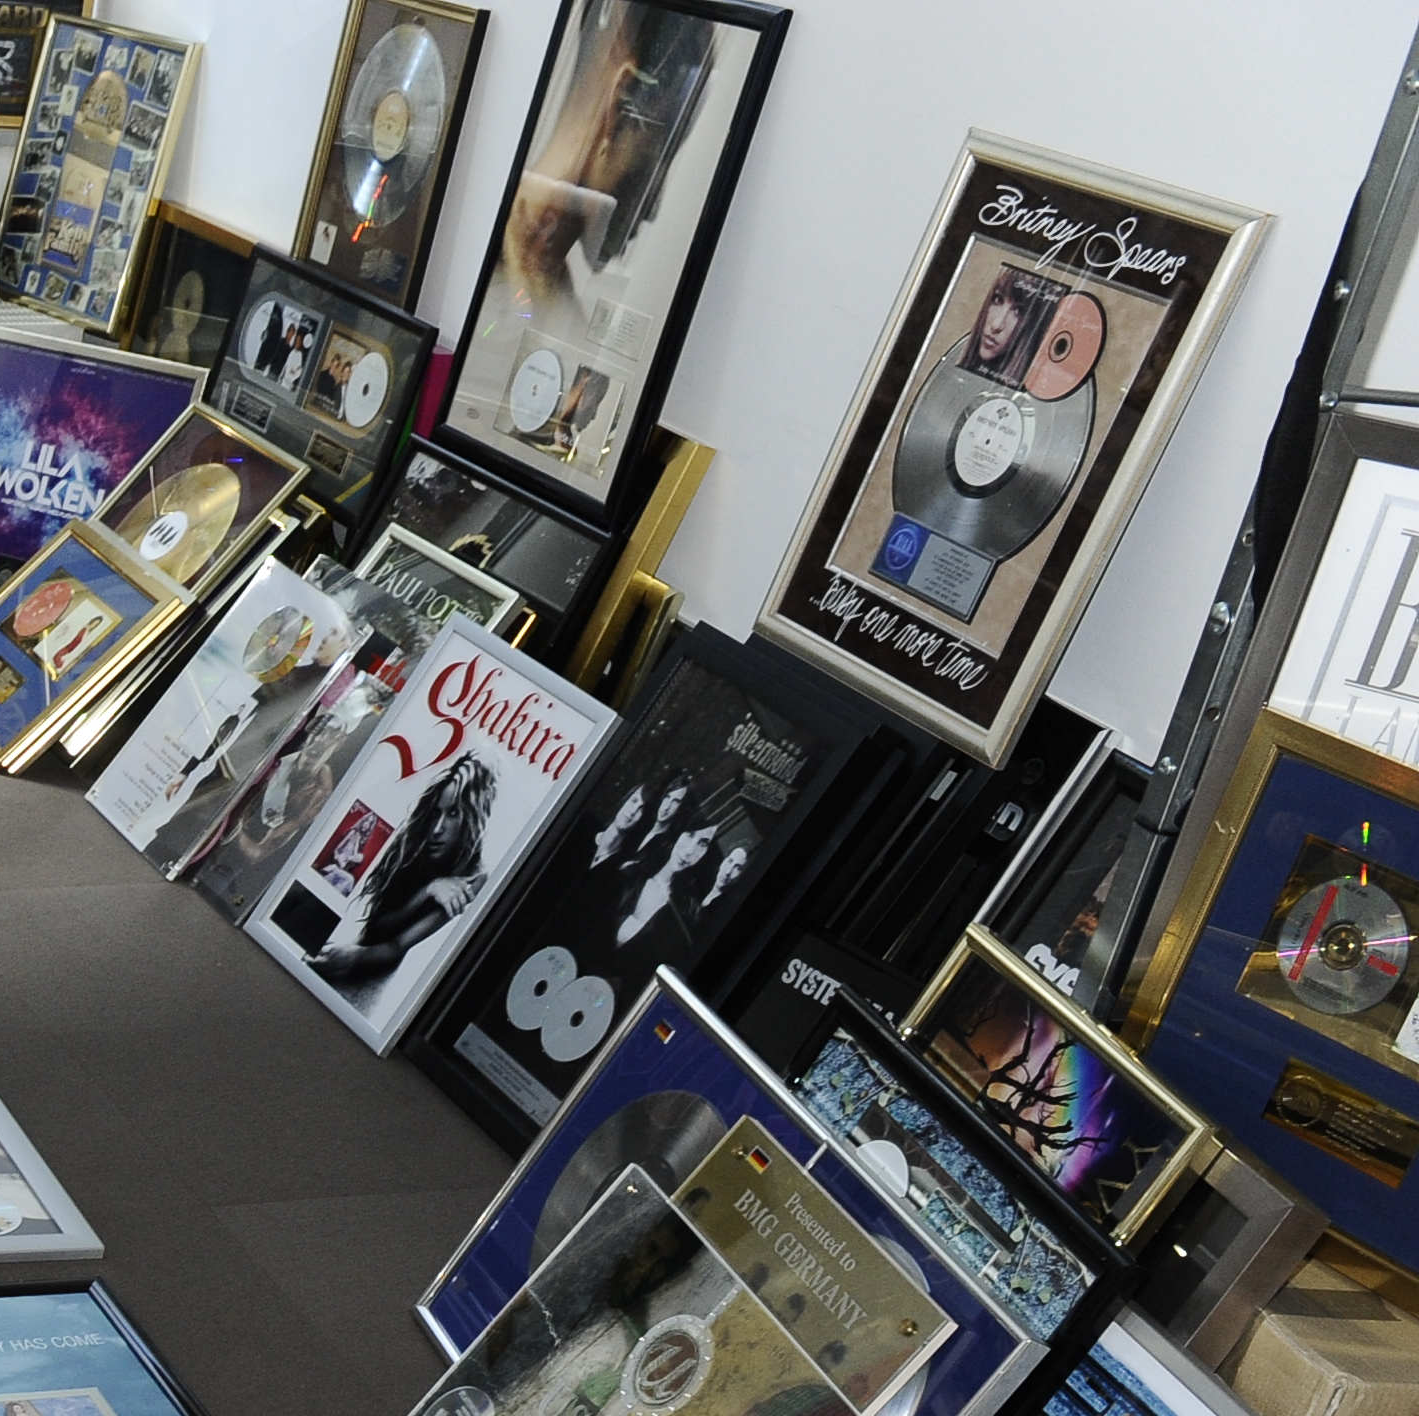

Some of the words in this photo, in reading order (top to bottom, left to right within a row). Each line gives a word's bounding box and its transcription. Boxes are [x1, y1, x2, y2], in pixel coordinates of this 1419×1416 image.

[979, 184, 1089, 270] Britney
[1084, 217, 1187, 284] Spears
[20, 437, 85, 481] LILA
[374, 559, 423, 607] PAUL
[378, 653, 576, 783] Shakira
[781, 957, 841, 1007] SYSTE
[733, 1188, 773, 1240] BMG
[772, 1230, 868, 1331] GERMANY
[783, 1191, 843, 1258] Presented
[840, 1250, 858, 1273] to
[11, 1338, 48, 1352] HAS
[52, 1332, 107, 1349] COME
